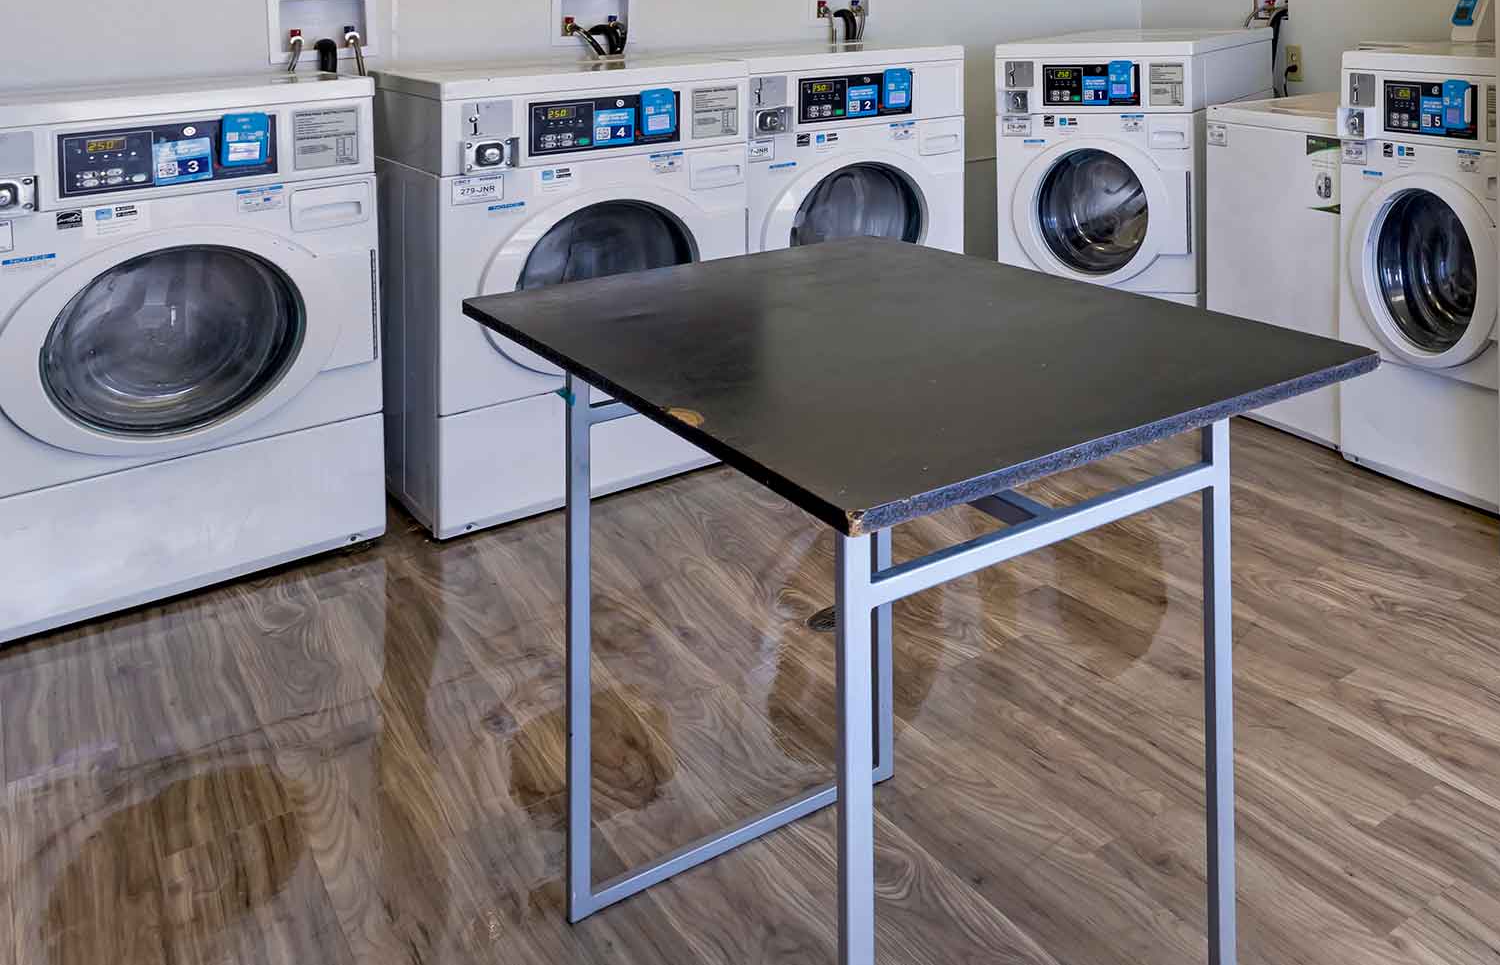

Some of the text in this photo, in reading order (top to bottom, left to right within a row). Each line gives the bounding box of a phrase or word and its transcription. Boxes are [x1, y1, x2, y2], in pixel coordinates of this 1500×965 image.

[1098, 91, 1104, 99] 1
[864, 101, 871, 110] 2
[548, 109, 567, 119] 250
[1434, 116, 1441, 127] 5
[616, 127, 626, 137] 4
[88, 139, 113, 151] 250
[188, 160, 199, 173] 3
[460, 185, 495, 195] 279-JNR
